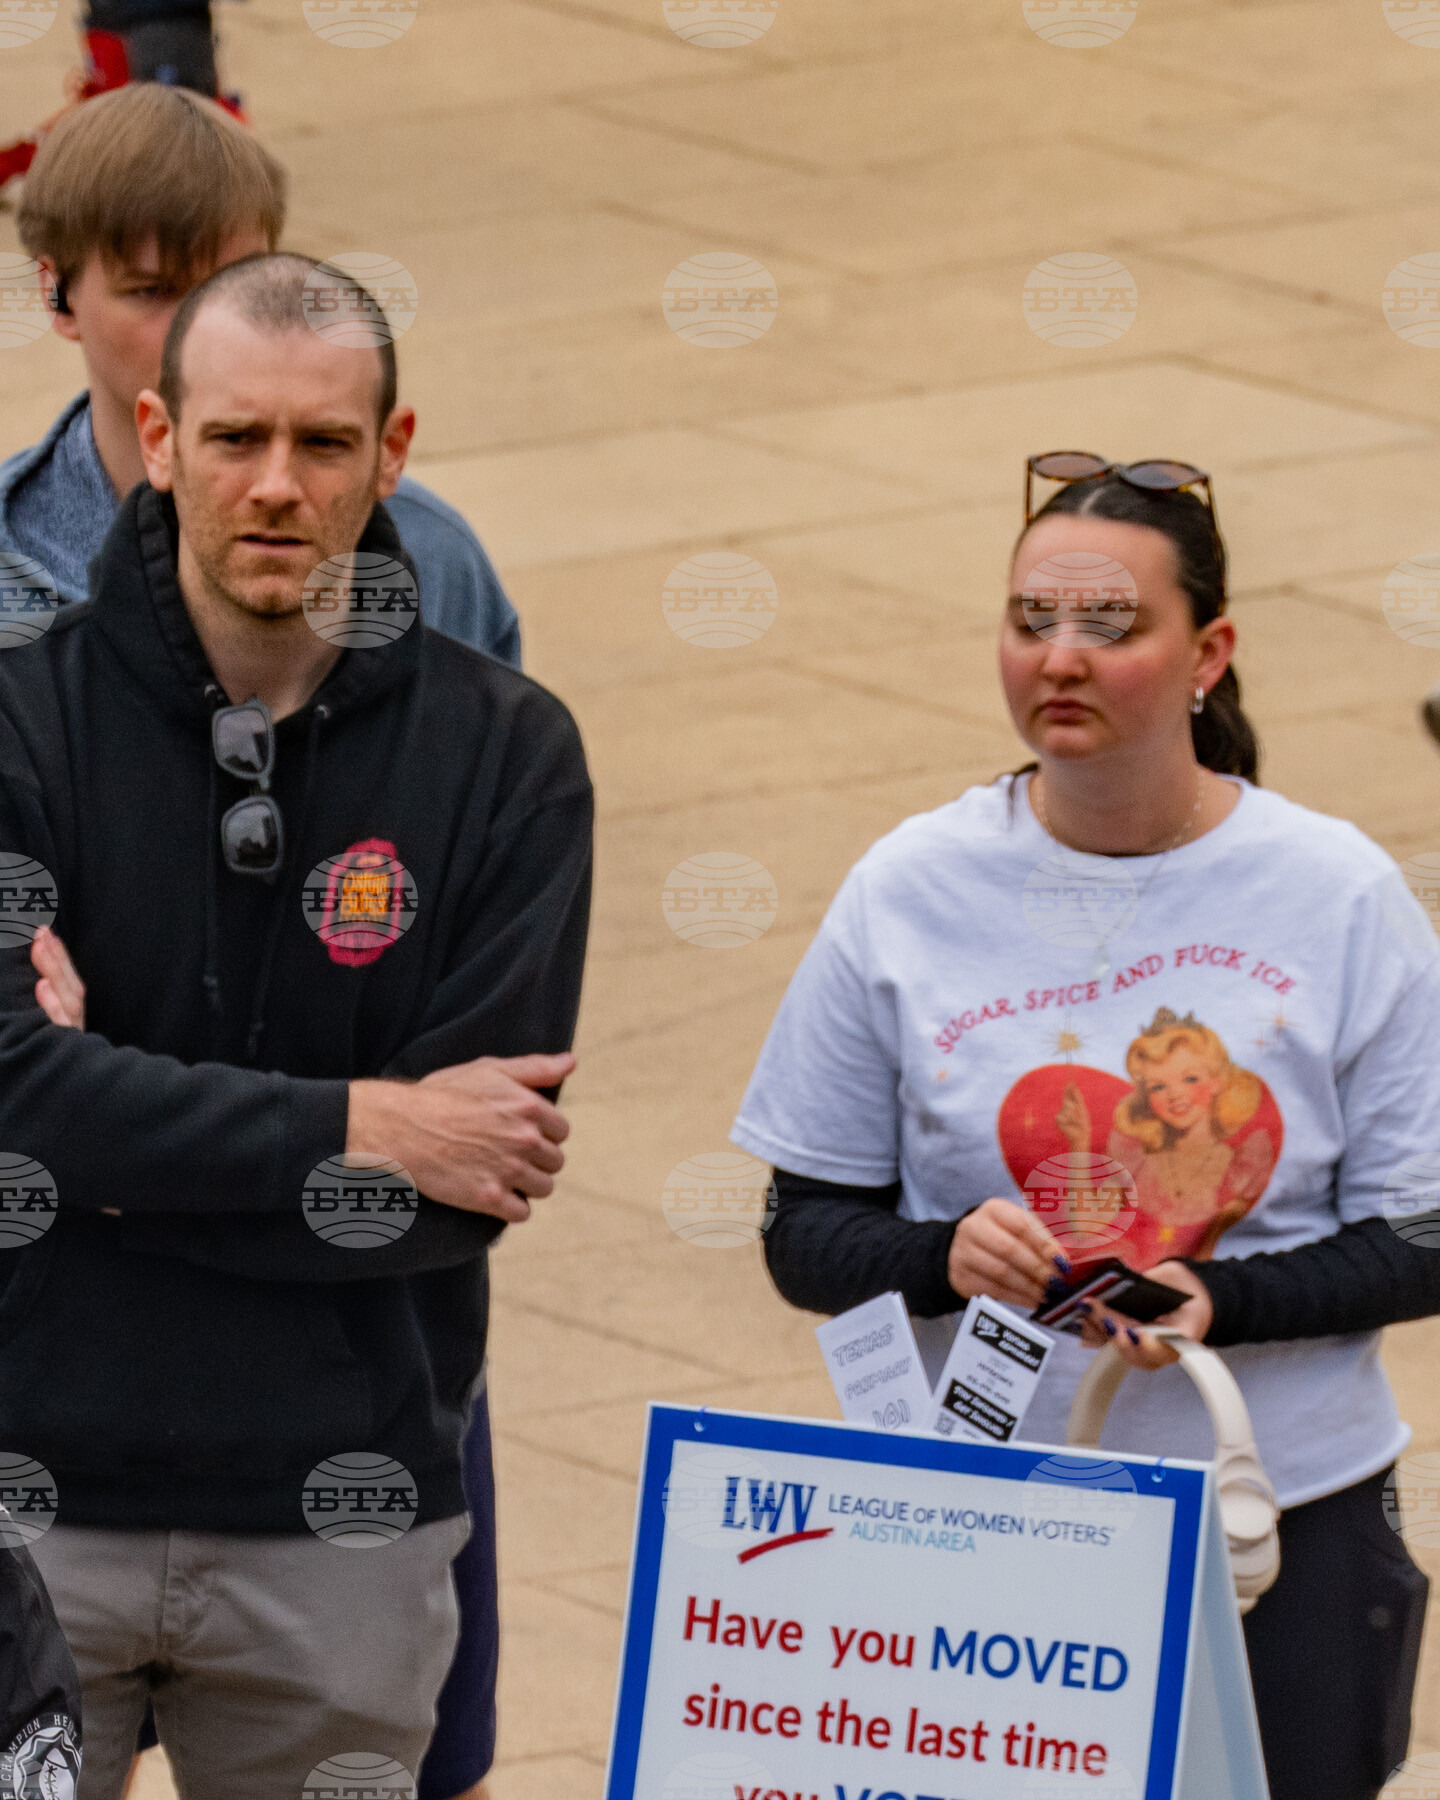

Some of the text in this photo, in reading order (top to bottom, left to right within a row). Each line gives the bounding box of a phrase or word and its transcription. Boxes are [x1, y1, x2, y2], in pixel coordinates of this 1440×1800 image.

[1023, 979, 1101, 1012] SPICE
[1111, 954, 1164, 994] AND
[1173, 943, 1247, 971] FUCK
[1249, 959, 1296, 996] ICE
[832, 1322, 894, 1367] TEXAS
[721, 1475, 818, 1534] LWV
[829, 1493, 910, 1523] LEAGUE
[941, 1508, 1025, 1536] WOMEN
[1028, 1517, 1113, 1547] VOTERS
[849, 1521, 978, 1554] AUSTIN AREA
[682, 1596, 1130, 1692] Have you MOVED
[1, 1718, 41, 1782] CHAMPION
[682, 1682, 1109, 1778] since the last time
